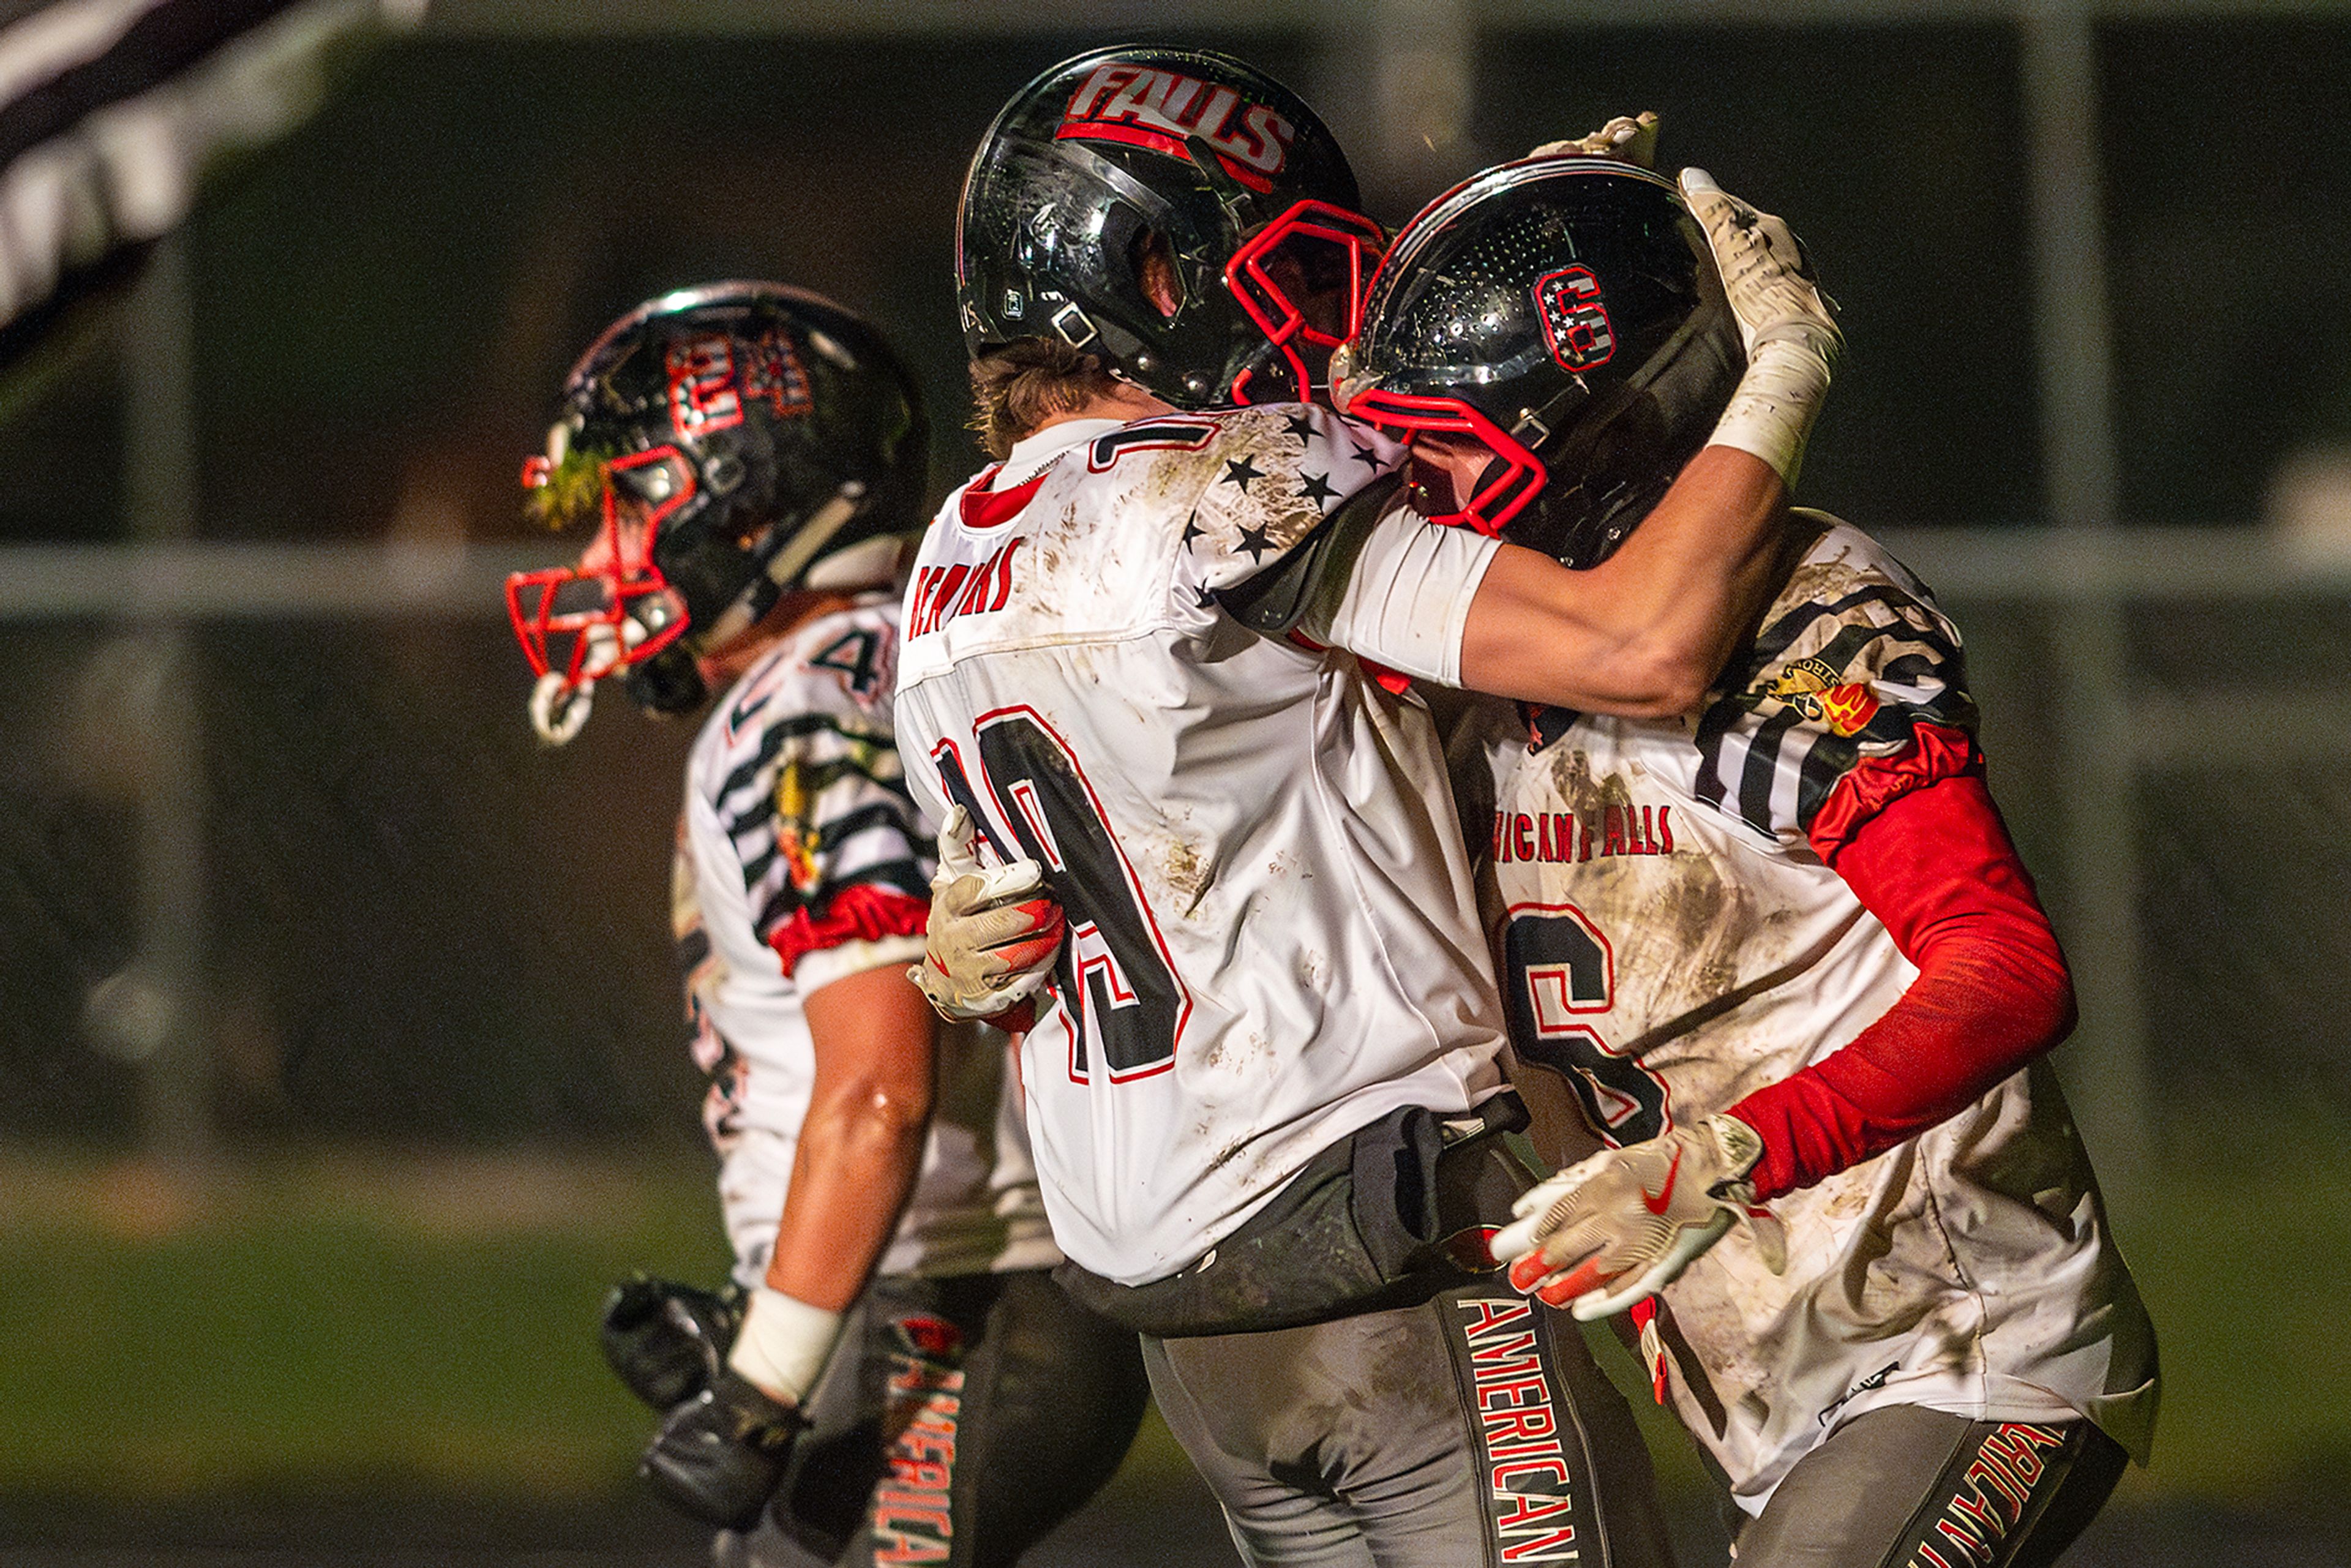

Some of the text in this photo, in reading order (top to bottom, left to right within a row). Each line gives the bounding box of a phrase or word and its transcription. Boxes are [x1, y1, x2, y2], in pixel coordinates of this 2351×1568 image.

[1066, 63, 1294, 174] FALLS
[1532, 264, 1617, 373] 6
[930, 704, 1193, 1085] 19
[1499, 902, 1674, 1149] 6
[1457, 1298, 1578, 1564] AMERICAN
